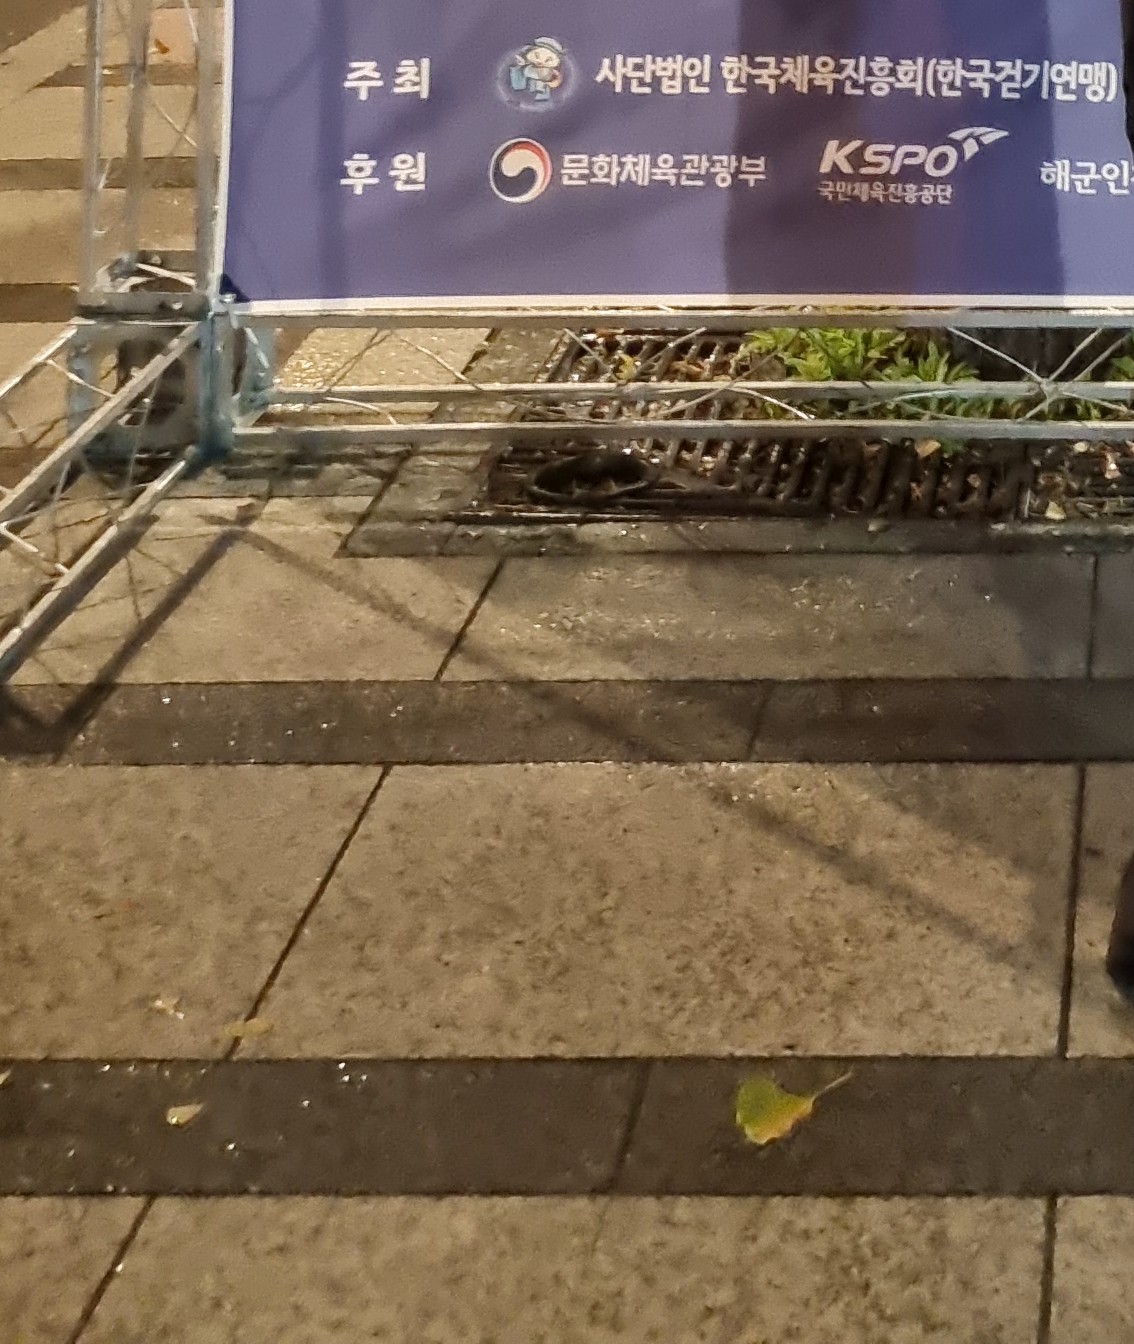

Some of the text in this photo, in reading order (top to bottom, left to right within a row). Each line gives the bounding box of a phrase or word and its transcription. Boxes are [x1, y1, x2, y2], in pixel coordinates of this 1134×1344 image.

[594, 54, 712, 95] 사단법인
[560, 153, 768, 189] 문화체육관광부
[818, 139, 959, 179] KSPO
